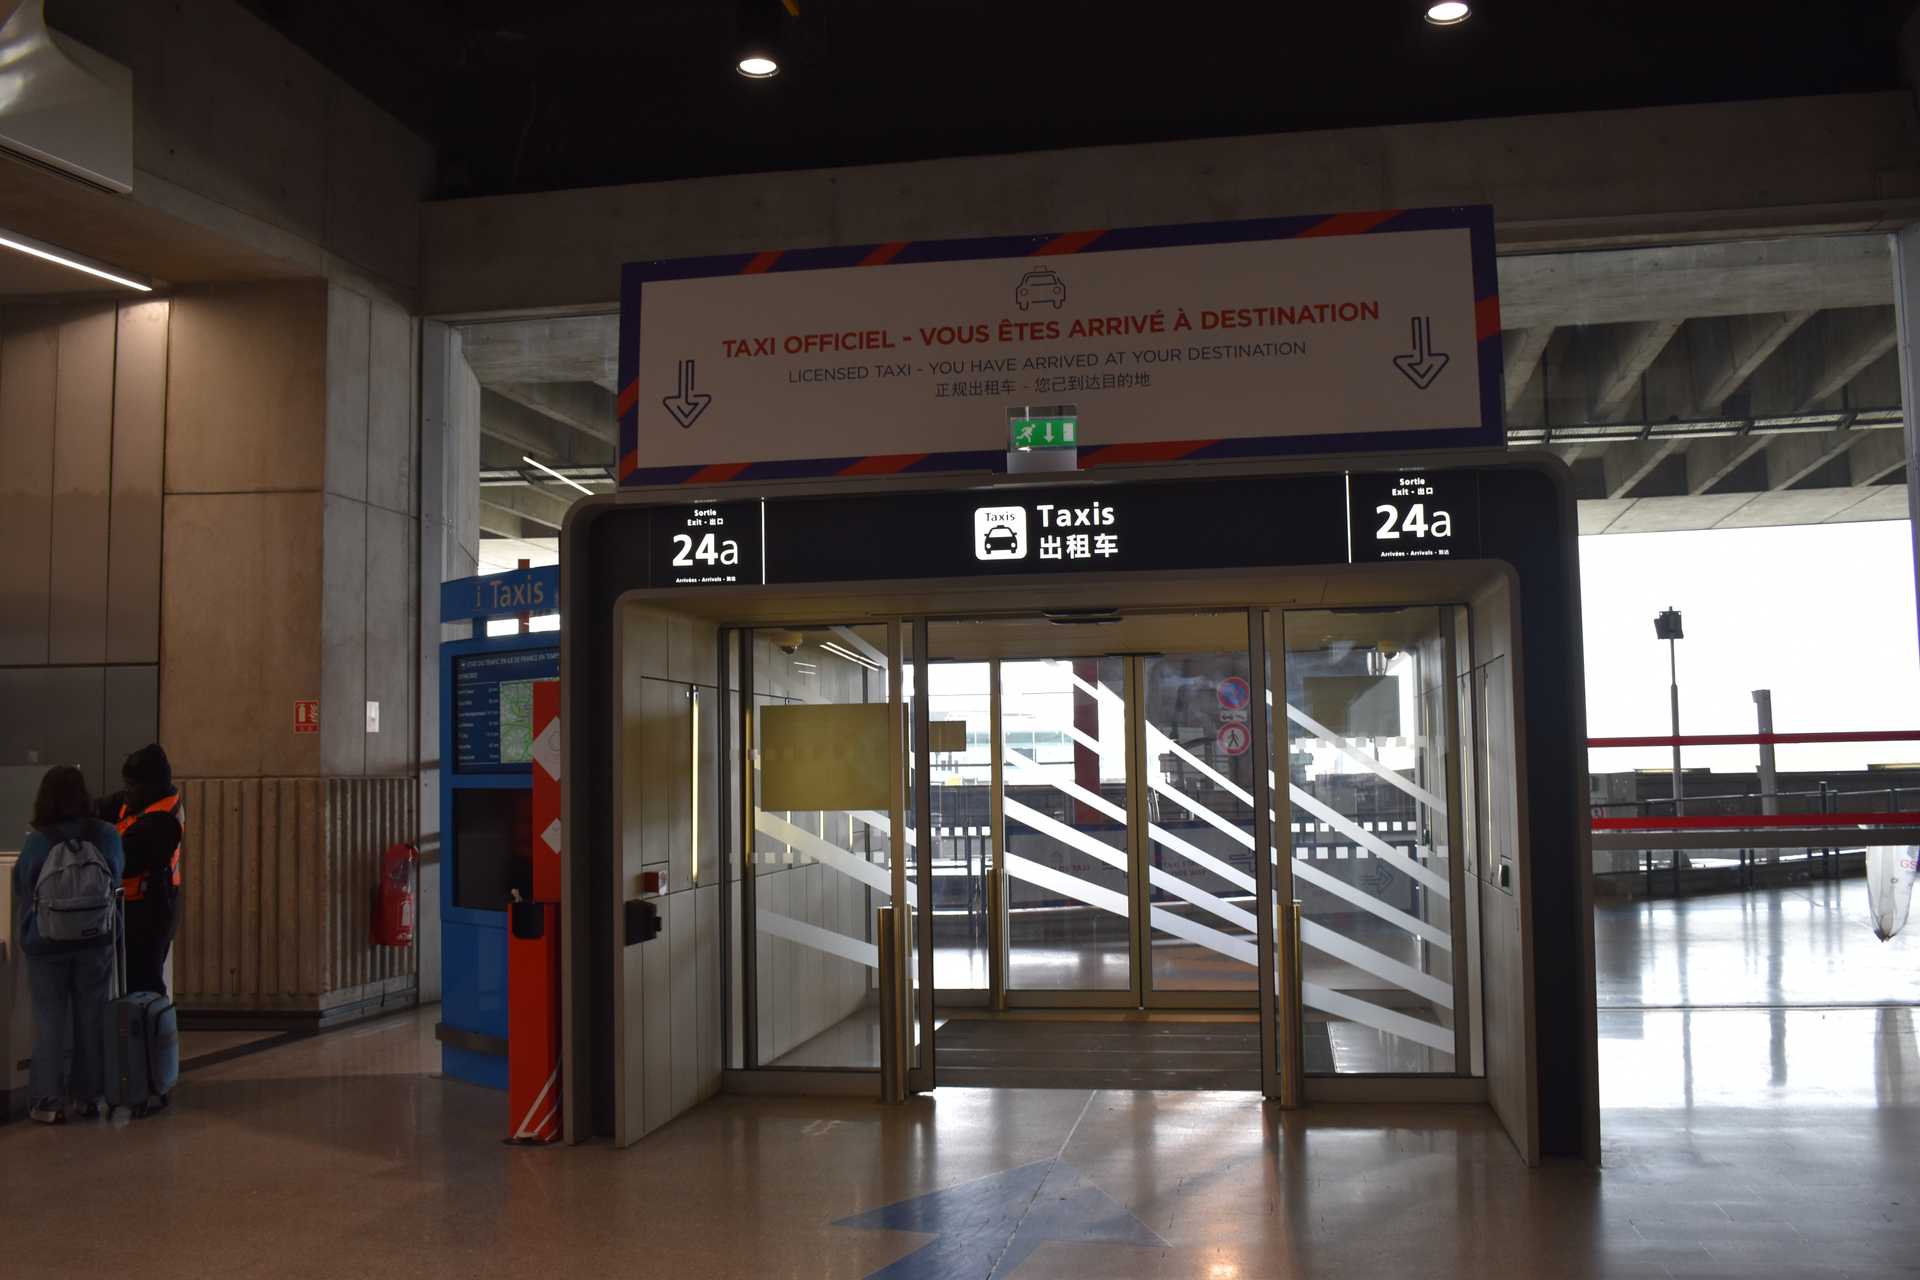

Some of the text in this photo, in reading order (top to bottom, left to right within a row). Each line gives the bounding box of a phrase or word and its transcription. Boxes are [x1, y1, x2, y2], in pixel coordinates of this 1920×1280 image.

[722, 337, 776, 358] TAXI
[784, 328, 896, 354] OFFICIEL
[919, 324, 990, 346] VOUS
[998, 317, 1060, 342] ÊTES
[1068, 310, 1165, 338] ARRIVÉ
[1173, 307, 1192, 331] À
[1200, 301, 1380, 330] DESTINATION
[789, 365, 869, 384] LICENSED
[875, 363, 911, 379] TAXI
[929, 359, 964, 376] YOU
[971, 357, 1016, 373] HAVE
[1023, 353, 1099, 370] ARRIVED
[1105, 350, 1127, 366] AT
[1133, 347, 1182, 363] YOUR
[1188, 340, 1307, 361] DESTINATION
[936, 379, 1017, 398] 正规出租车
[1392, 487, 1409, 496] Exit
[1399, 476, 1426, 486] Sortie
[687, 518, 702, 526] Exit
[693, 508, 717, 517] Sortie
[984, 511, 1016, 522] Taxis
[1036, 501, 1115, 528] Taxis
[1375, 503, 1452, 540] 24a
[672, 532, 739, 567] 24a
[1039, 533, 1119, 560] 出租车
[489, 574, 544, 608] Taxis
